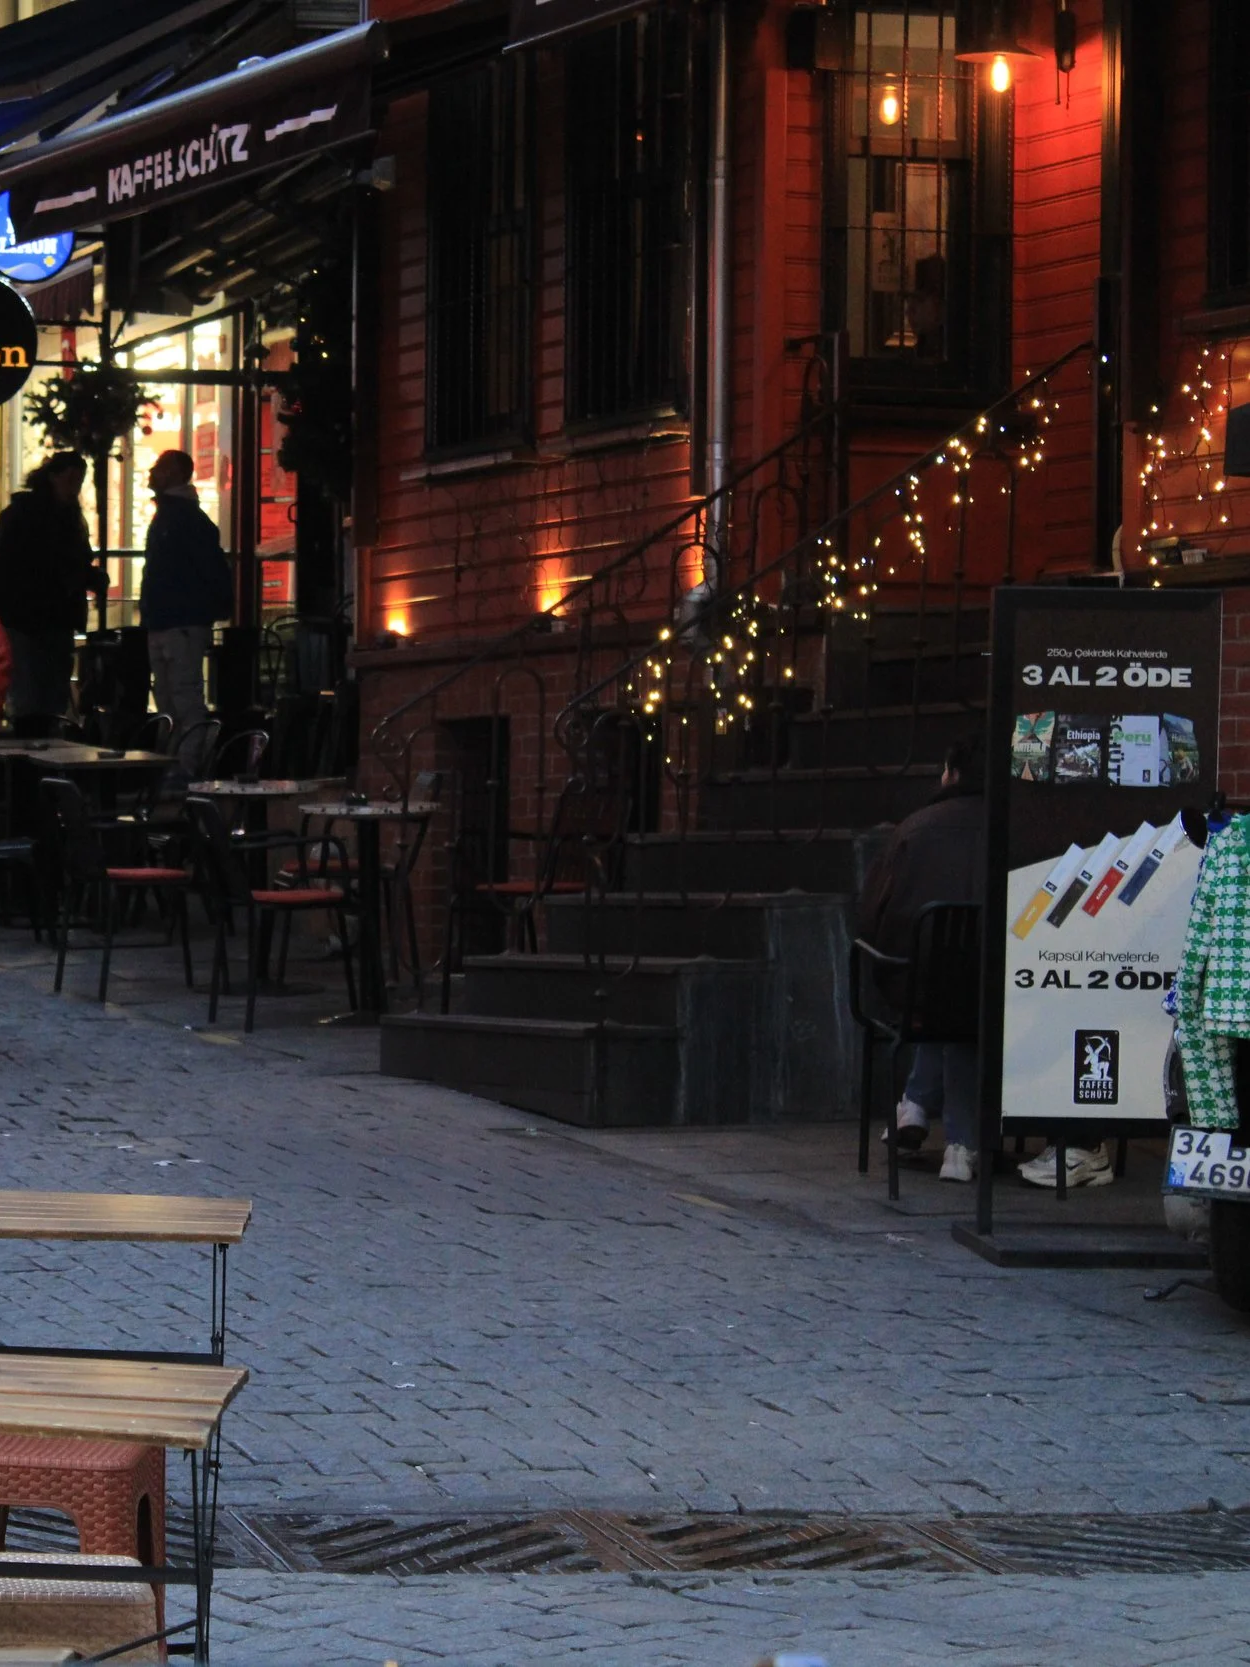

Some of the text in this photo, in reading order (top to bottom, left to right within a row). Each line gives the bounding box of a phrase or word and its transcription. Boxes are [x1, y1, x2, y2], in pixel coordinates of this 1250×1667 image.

[1074, 648, 1116, 659] Çekirdek
[1116, 649, 1168, 659] Kahvelerde
[1022, 662, 1192, 688] 3 AL 2 ÖDE
[1066, 730, 1101, 742] Ethiopia
[1113, 731, 1152, 743] Peru
[1038, 950, 1160, 964] Kapsül Kahvelerde
[1014, 969, 1035, 989] 3
[1040, 969, 1082, 989] AL
[1087, 970, 1109, 990] 2
[1079, 1080, 1113, 1090] KAFFEE
[1079, 1089, 1113, 1100] SCHÜTZ
[1176, 1132, 1212, 1158] 34
[1189, 1160, 1250, 1189] 469
